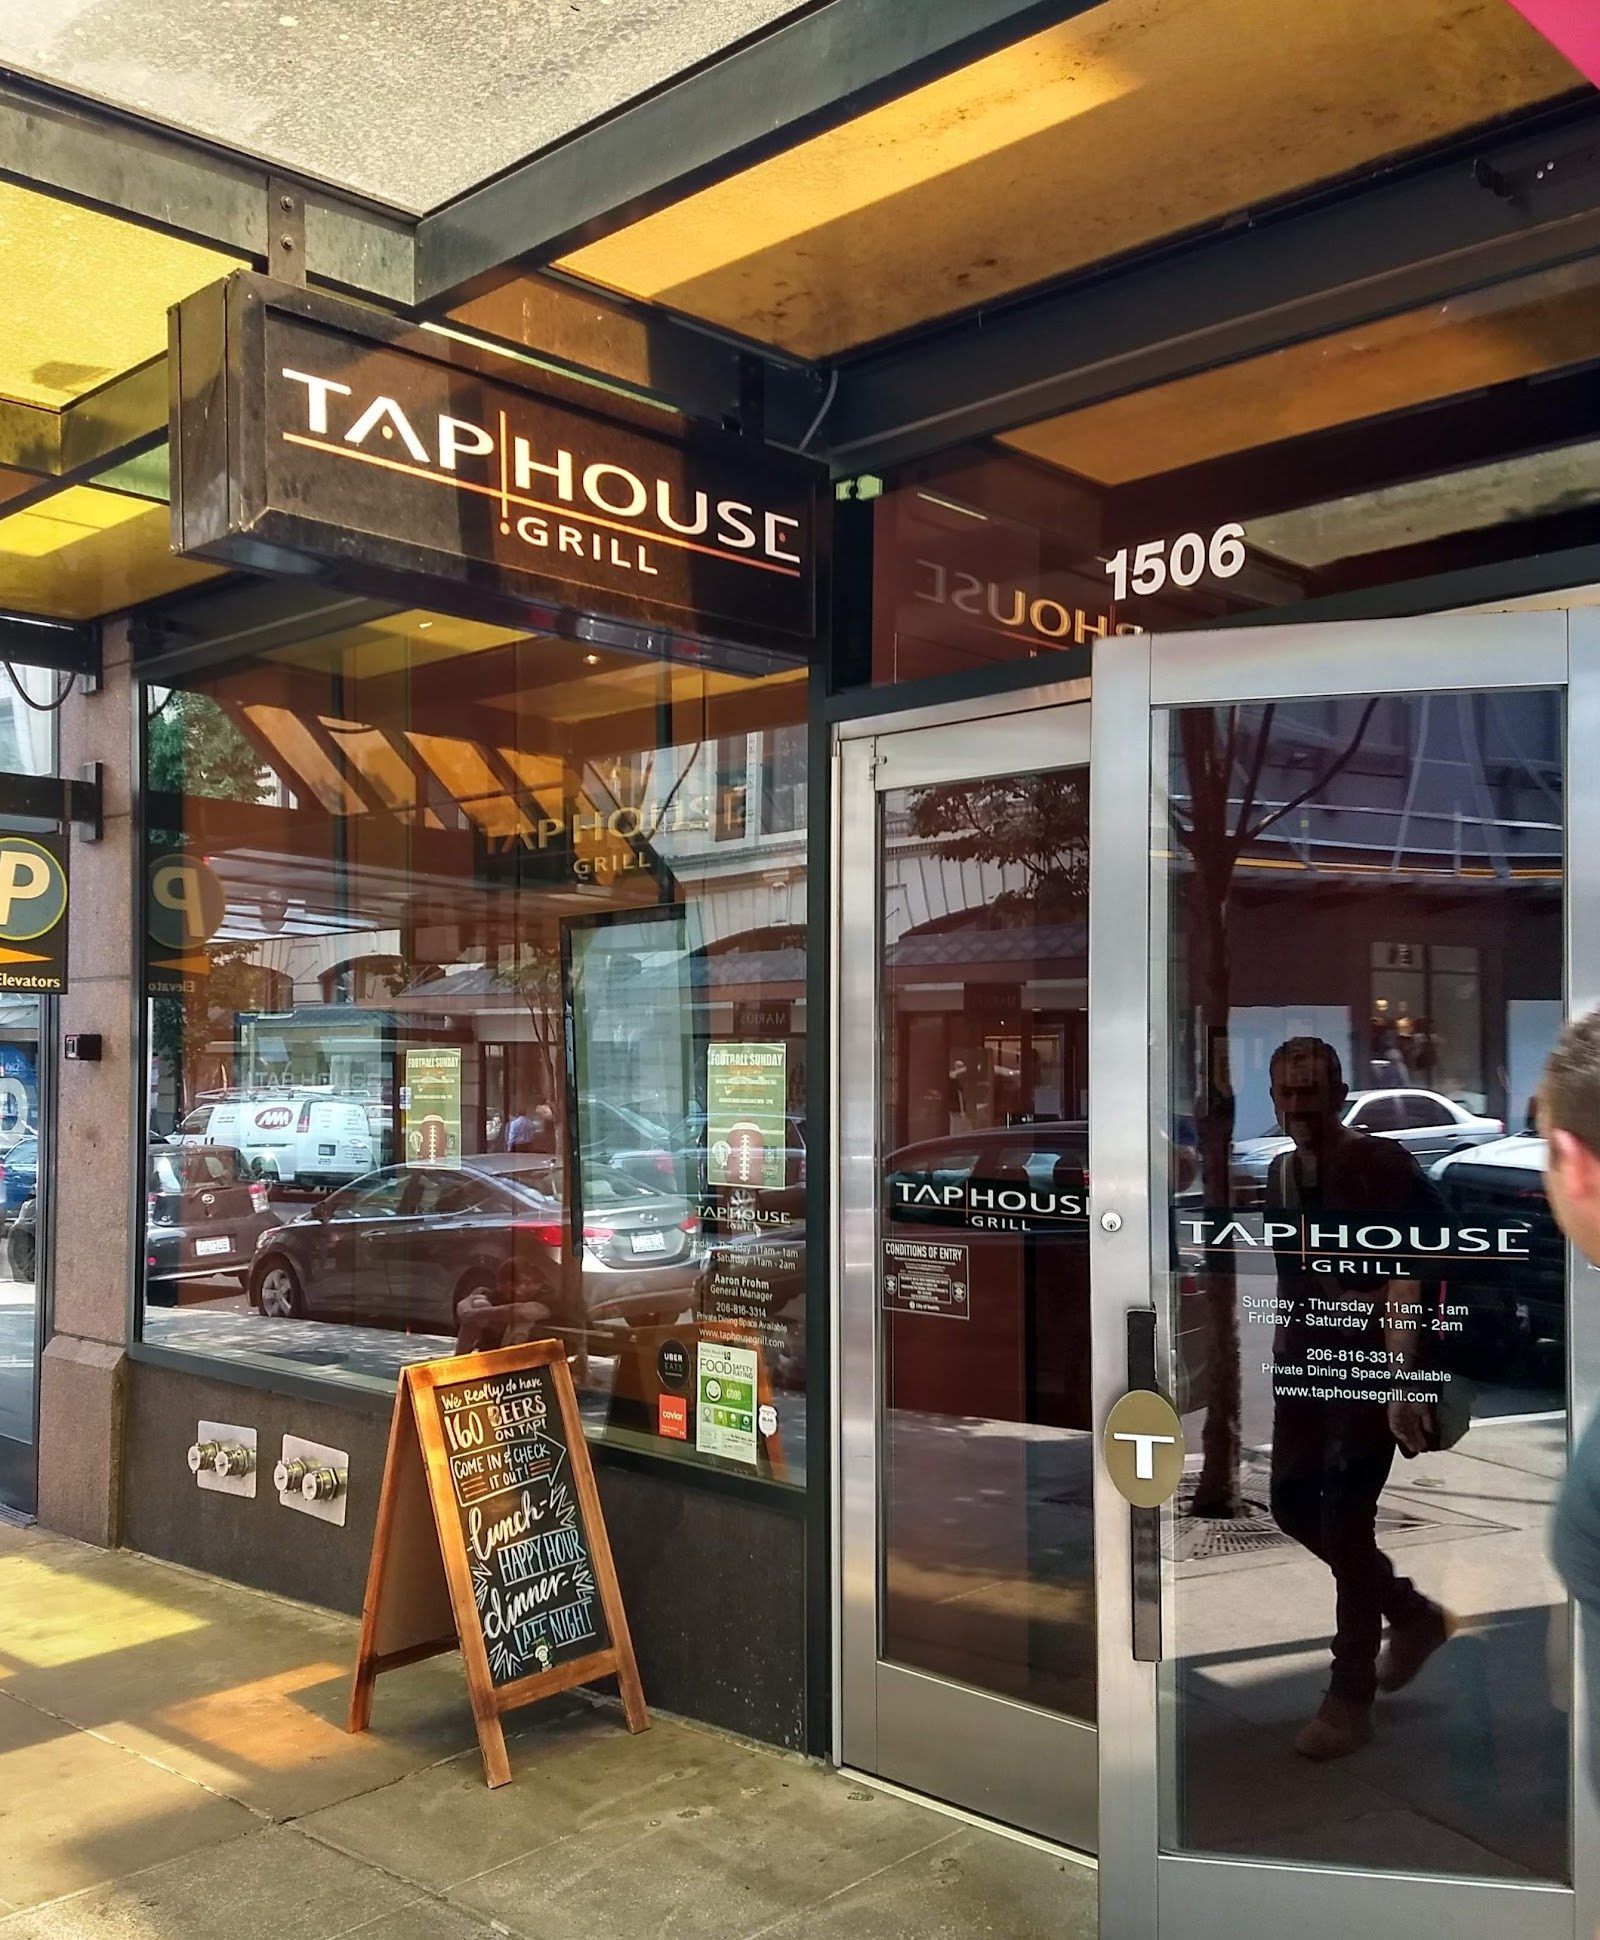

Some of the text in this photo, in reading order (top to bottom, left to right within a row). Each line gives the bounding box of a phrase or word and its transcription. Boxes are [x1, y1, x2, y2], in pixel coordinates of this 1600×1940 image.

[516, 516, 658, 575] GRILL
[1105, 523, 1246, 600] 1506
[573, 852, 650, 875] GRILL
[0, 851, 50, 926] P
[435, 1056, 459, 1068] SUNDAY
[711, 1053, 783, 1066] FOOTBALL SUNDAY
[896, 1181, 1090, 1216] TAPHOUS
[972, 1215, 1031, 1231] GRILL
[886, 1243, 928, 1259] CONDITIONS
[928, 1247, 938, 1259] OF
[940, 1248, 963, 1262] ENTRY
[779, 1259, 796, 1270] 2am
[1311, 1259, 1411, 1275] GRILL
[715, 1273, 770, 1290] Aaron Frohm
[710, 1284, 774, 1302] General Manager
[716, 1301, 767, 1319] 206-816-3314
[1242, 1295, 1295, 1313] Sunday
[1308, 1297, 1375, 1316] Thursday
[1384, 1301, 1424, 1314] 11am
[1438, 1303, 1469, 1316] 1am
[696, 1311, 717, 1322] Private
[759, 1320, 788, 1333] Available
[1248, 1311, 1291, 1328] Friday
[1305, 1313, 1369, 1331] Saturday
[1378, 1317, 1417, 1330] 11am
[1431, 1318, 1464, 1332] 2am
[664, 1353, 683, 1363] UBER
[1306, 1348, 1405, 1364] 206-816-3314
[700, 1357, 732, 1375] FOOD
[1261, 1363, 1452, 1382] Private Dining Space Available
[441, 1377, 543, 1411] We Really do have
[1274, 1385, 1438, 1404] www.taphousegrill.com
[444, 1395, 547, 1452] 160 BEERS
[662, 1409, 684, 1422] caviar
[495, 1427, 515, 1442] ON
[454, 1454, 485, 1480] COME
[487, 1451, 502, 1472] IN
[514, 1443, 551, 1464] CHECK
[1113, 1432, 1175, 1480] T
[489, 1475, 499, 1491] IT
[497, 1528, 588, 1584] HAPPY HOUR
[550, 1600, 594, 1644] NIGHT
